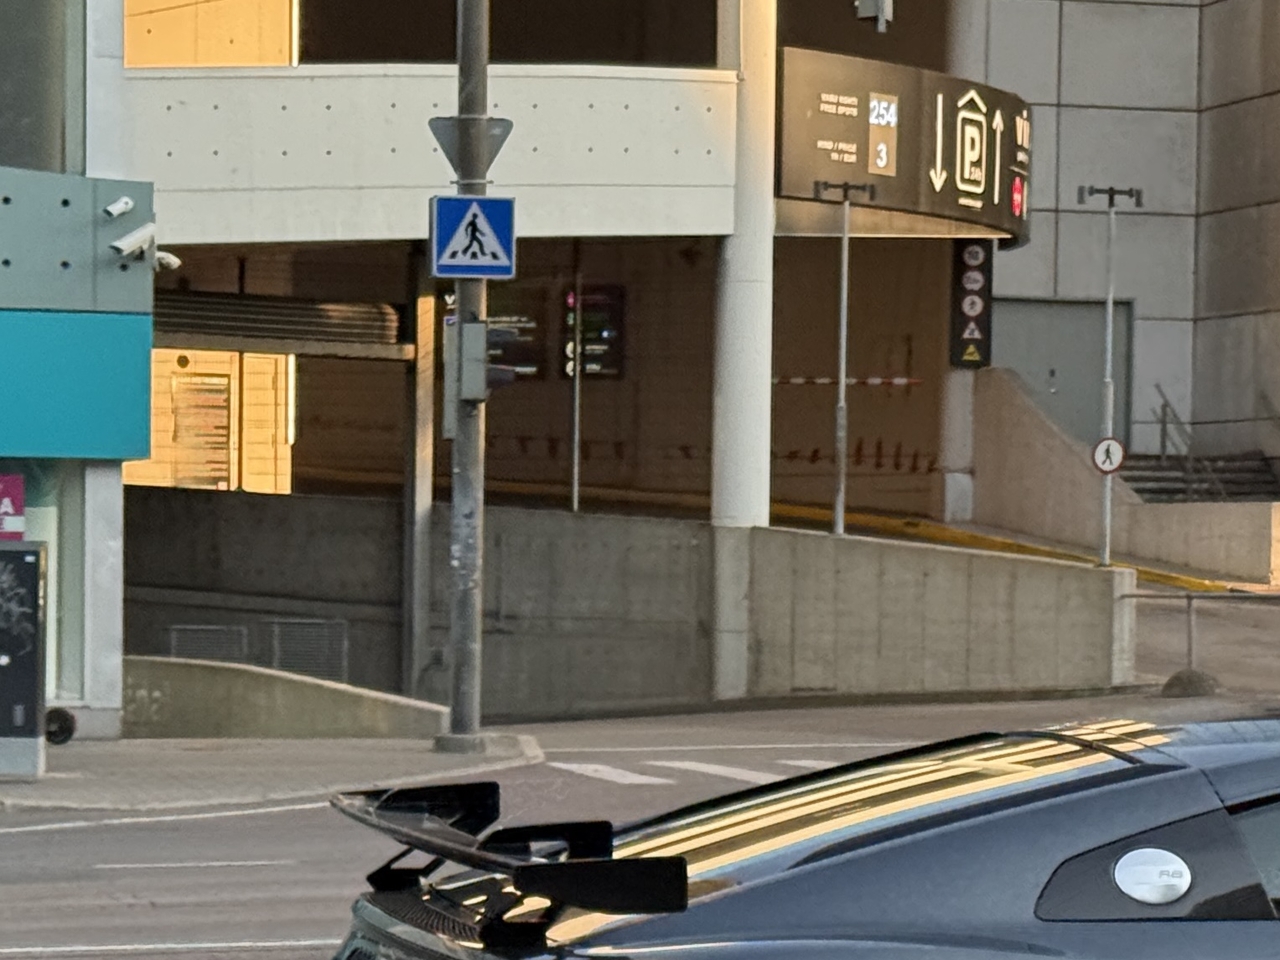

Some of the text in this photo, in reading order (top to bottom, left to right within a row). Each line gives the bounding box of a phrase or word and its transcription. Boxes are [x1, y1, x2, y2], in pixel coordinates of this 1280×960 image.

[869, 99, 898, 128] 254
[876, 142, 888, 168] 3
[964, 124, 981, 180] P
